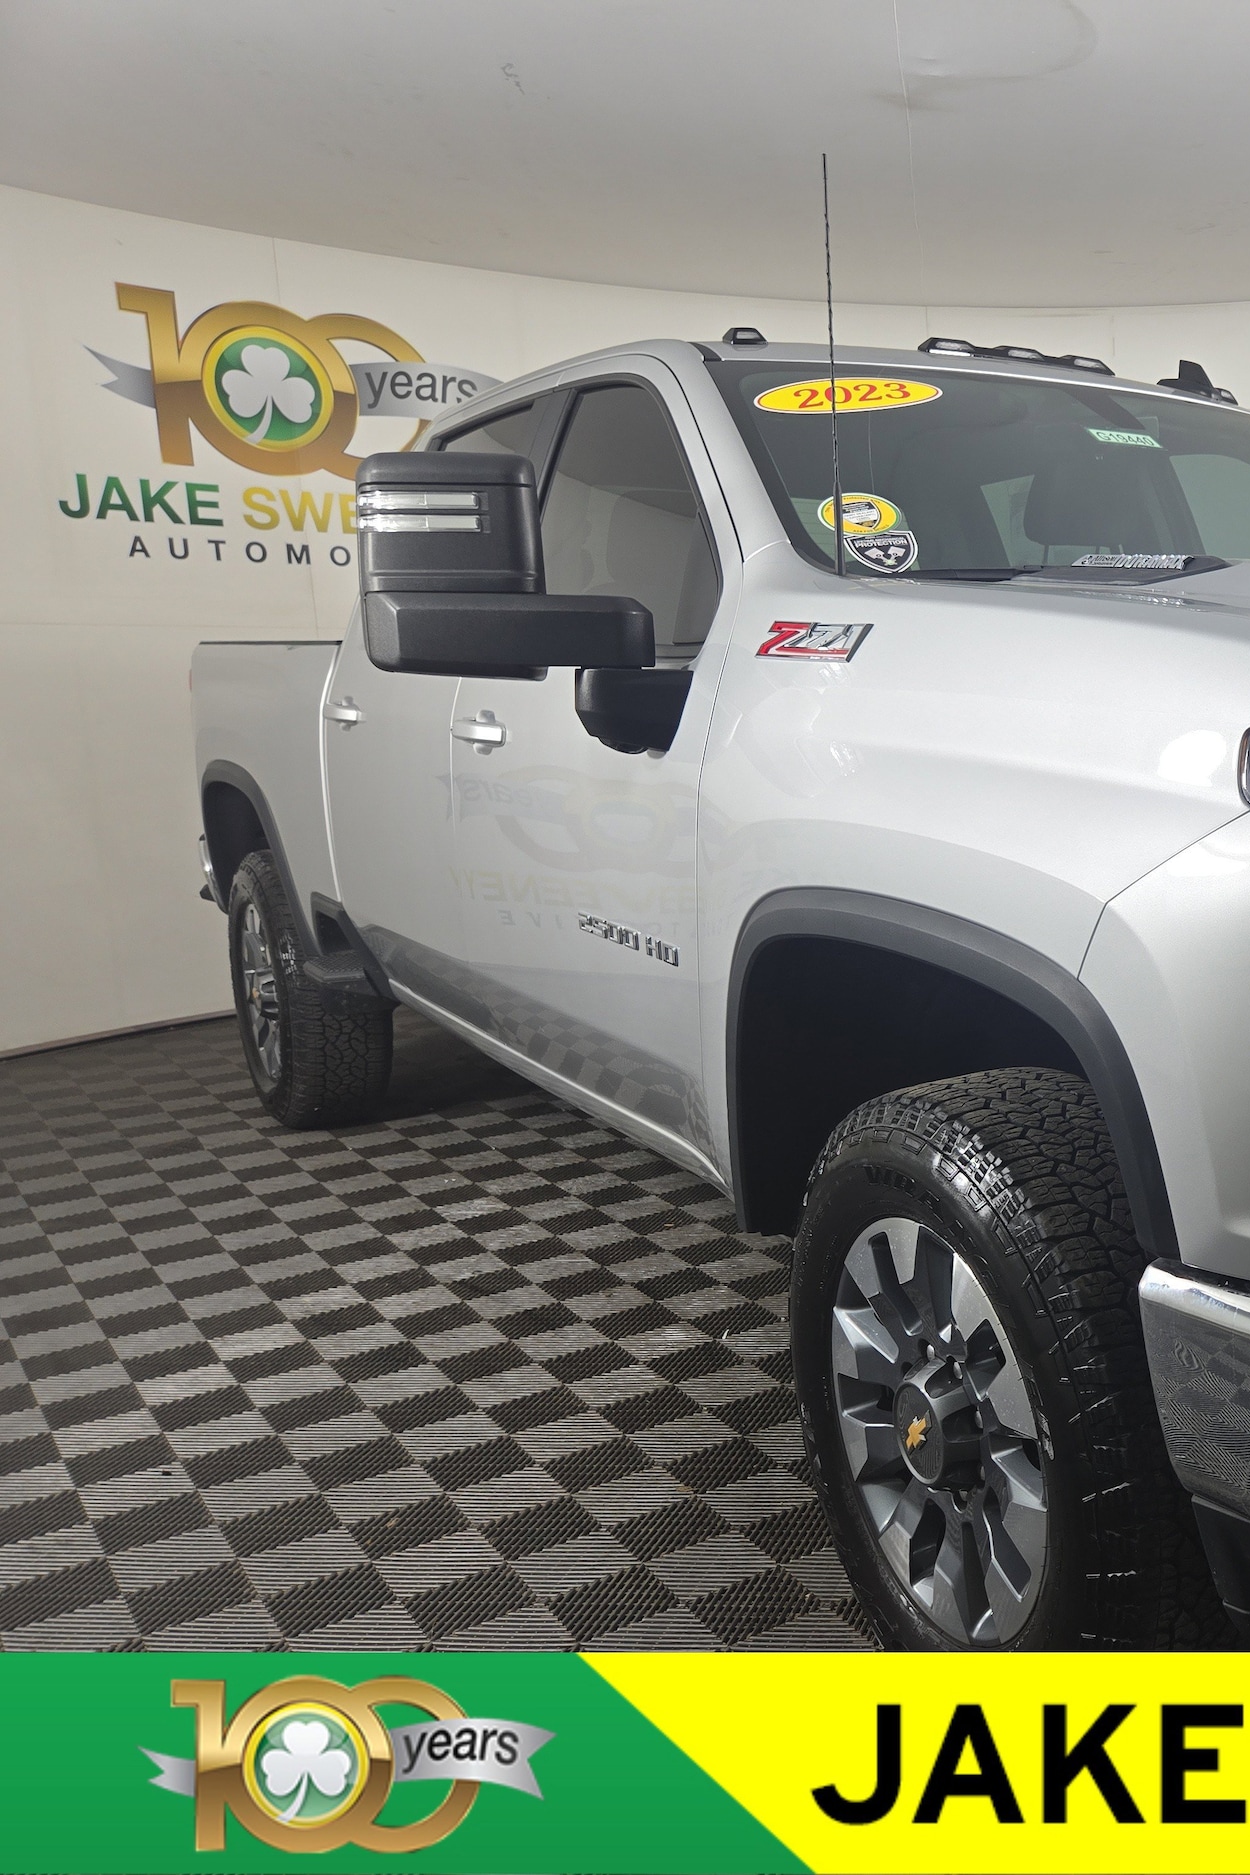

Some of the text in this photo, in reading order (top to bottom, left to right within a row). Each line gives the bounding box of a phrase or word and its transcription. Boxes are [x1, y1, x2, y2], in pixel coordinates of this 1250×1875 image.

[365, 370, 478, 409] years
[793, 382, 912, 410] 2023
[1096, 431, 1155, 446] G19440
[58, 473, 224, 527] JAKE
[755, 621, 874, 662] Z71
[578, 912, 641, 951] 2500
[645, 936, 680, 967] HD
